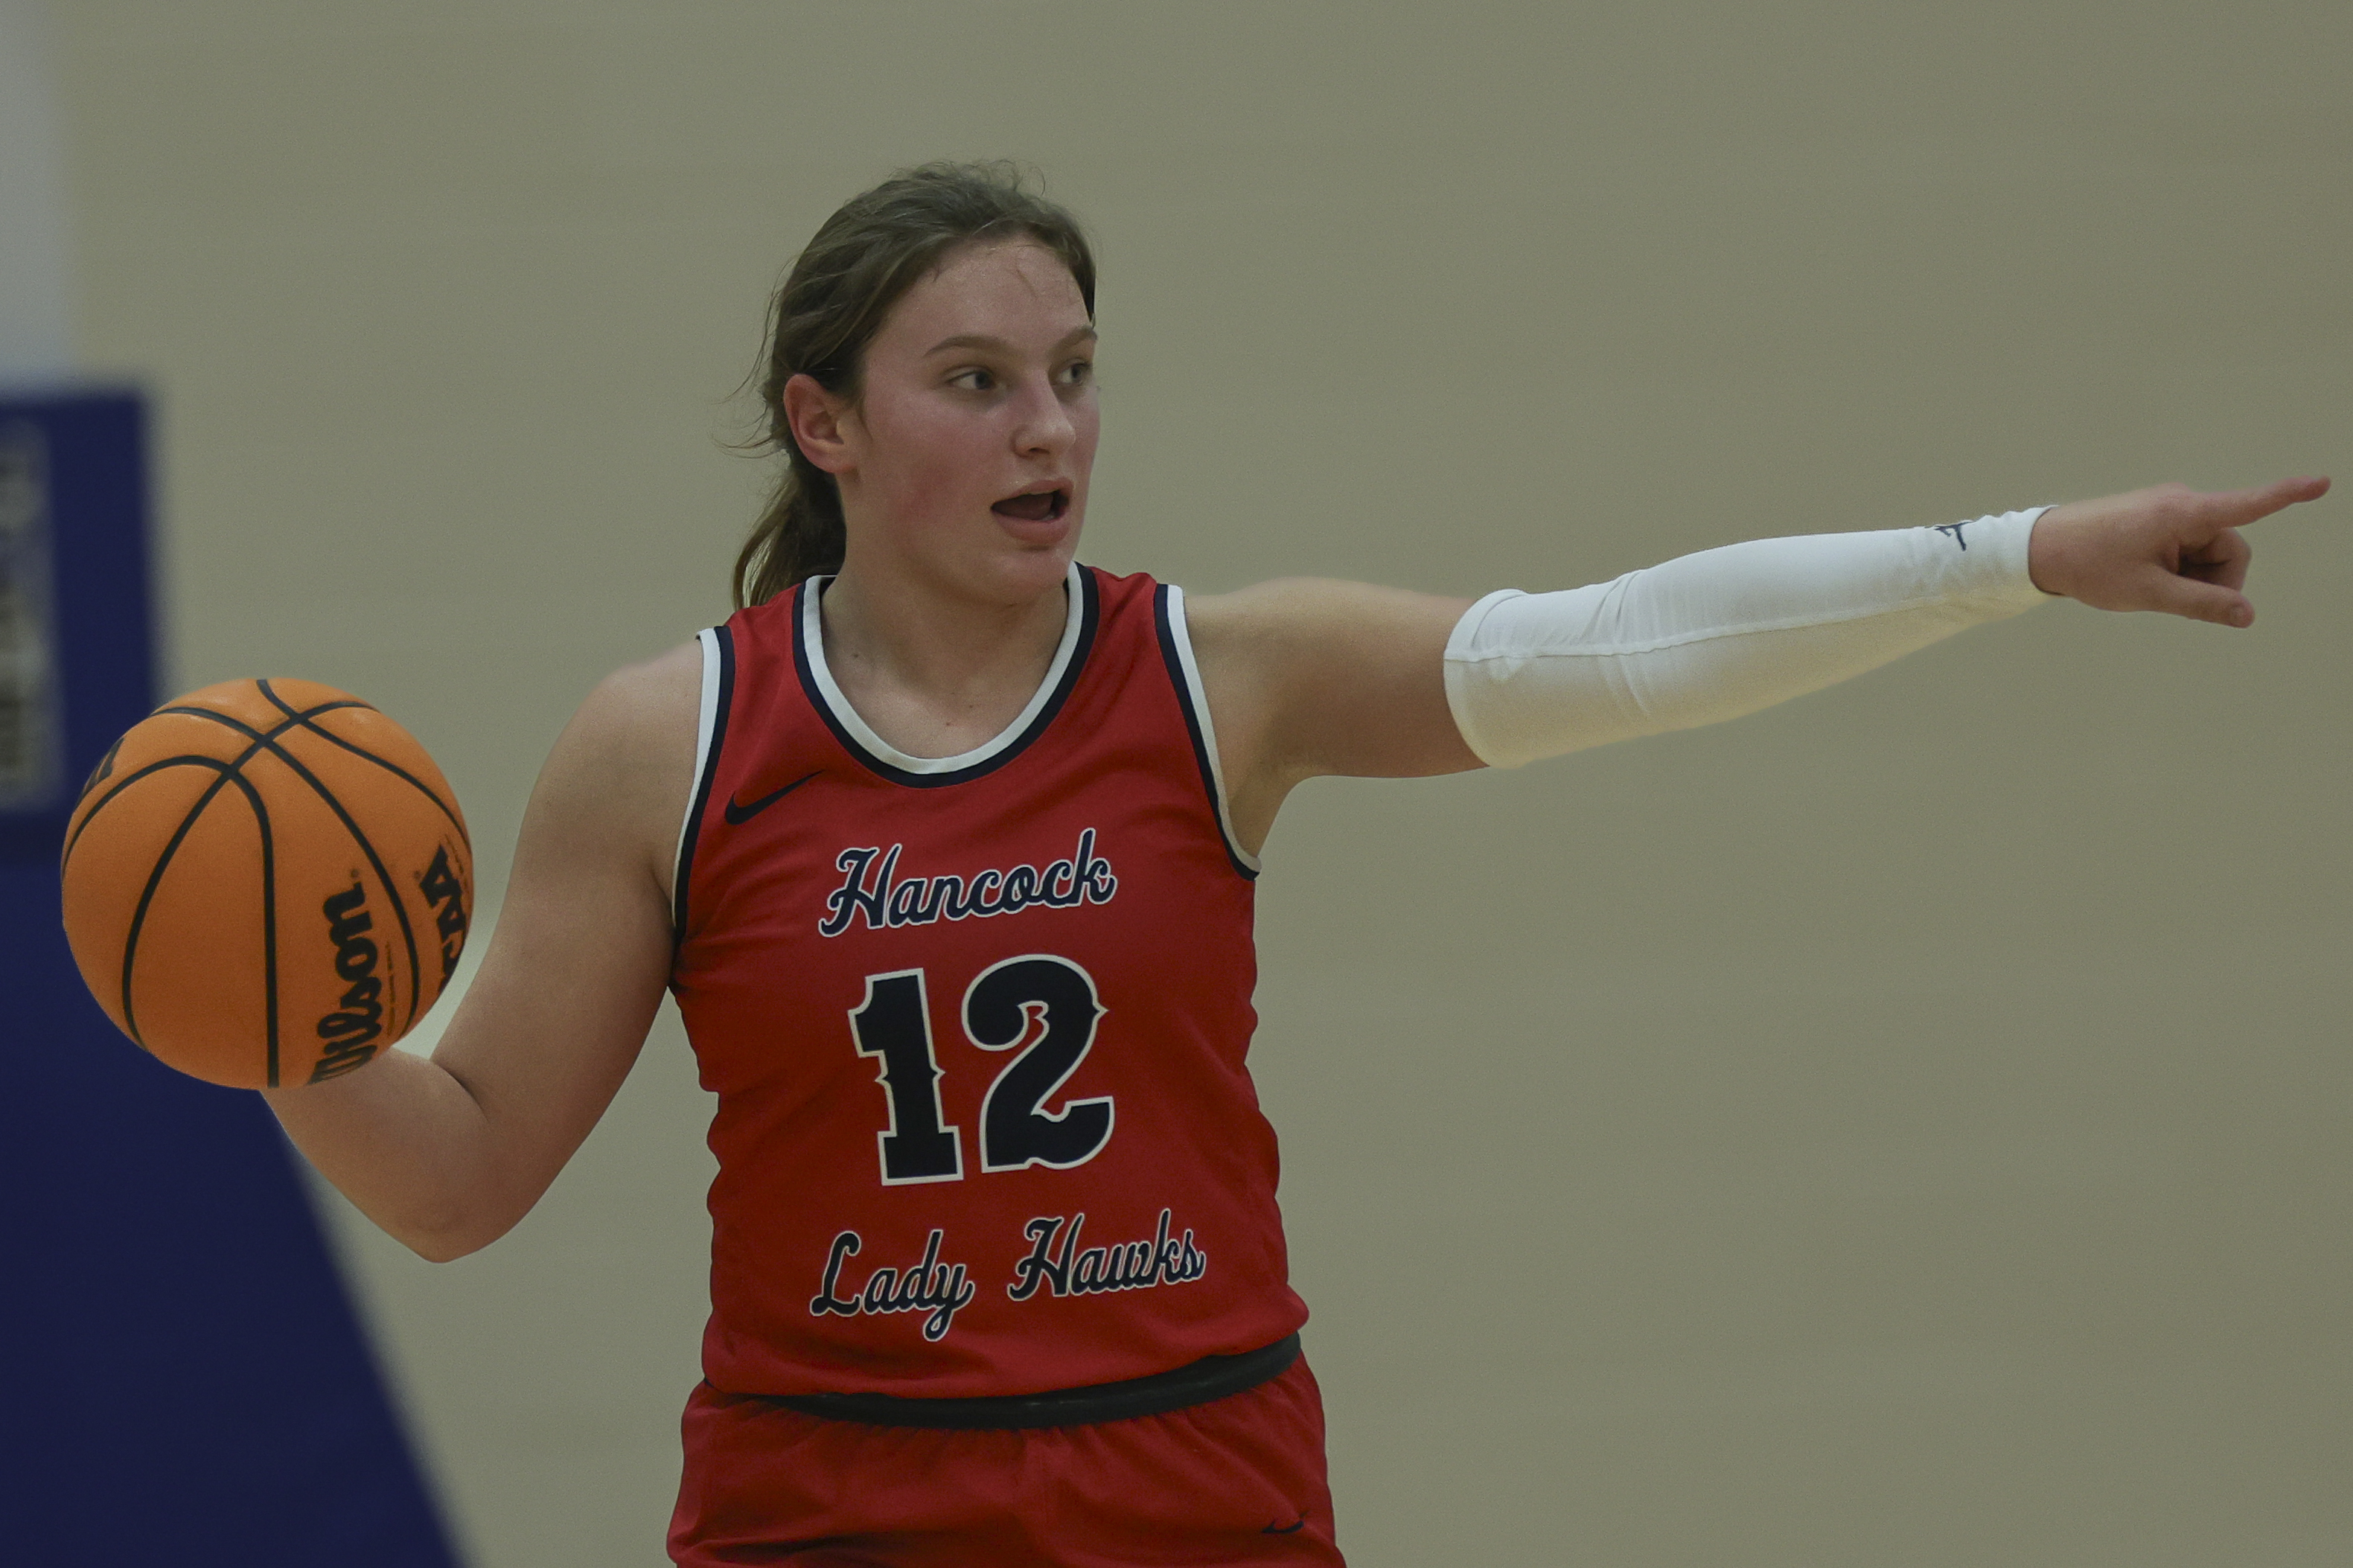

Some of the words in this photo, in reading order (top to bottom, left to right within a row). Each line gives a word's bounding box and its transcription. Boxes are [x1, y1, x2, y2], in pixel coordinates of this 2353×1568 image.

[418, 845, 467, 993] CAA
[818, 828, 1117, 937] Hancock
[306, 882, 383, 1086] Wilson
[847, 954, 1115, 1185] 12
[810, 1229, 974, 1342] Lady
[1007, 1208, 1207, 1301] Hawks
